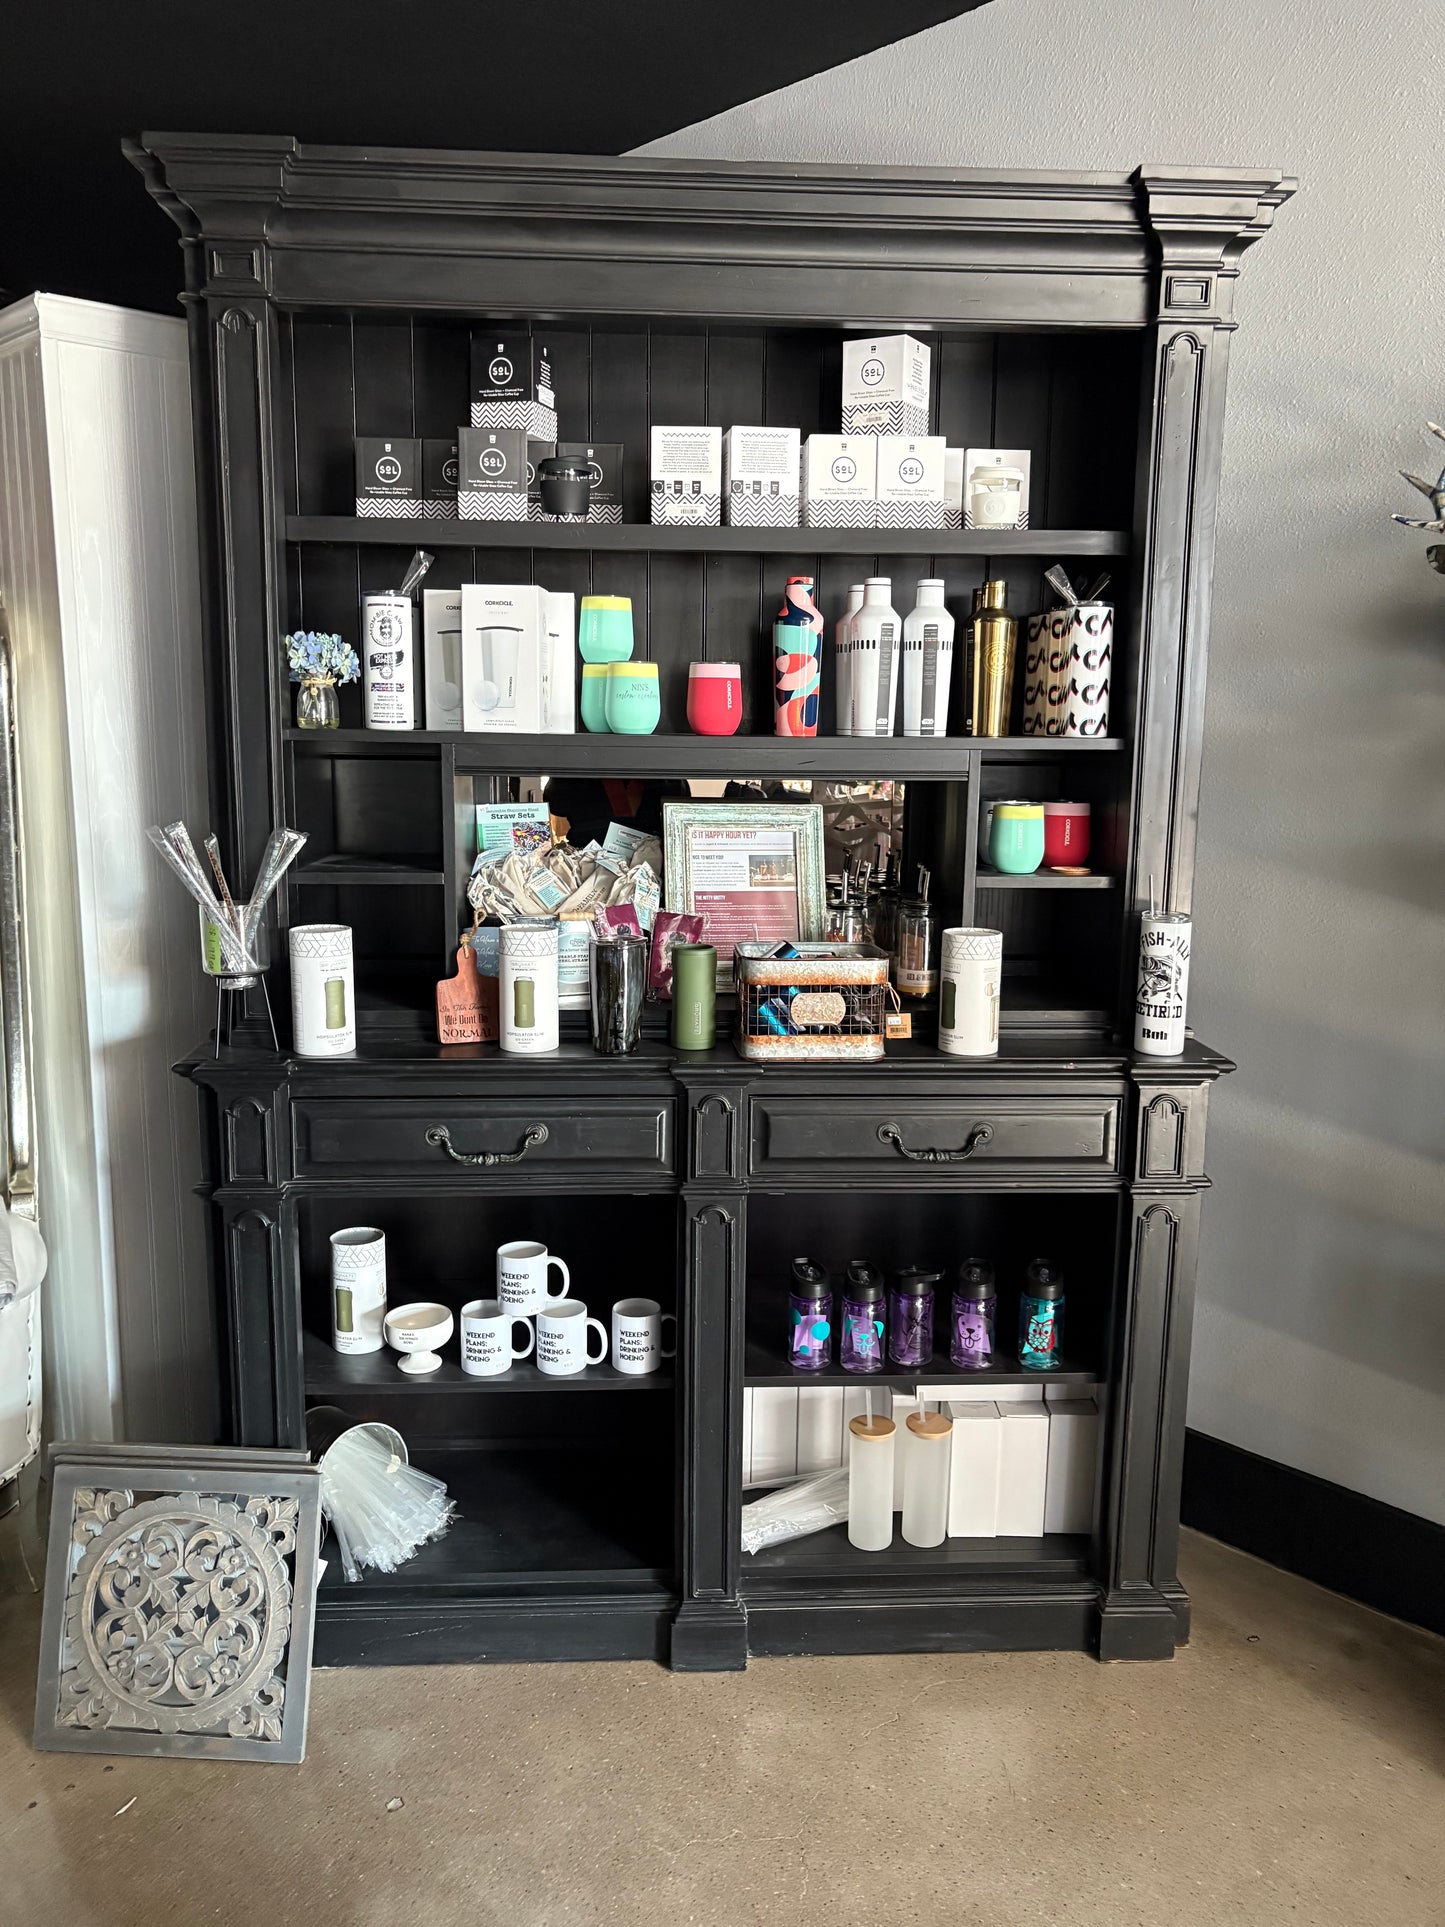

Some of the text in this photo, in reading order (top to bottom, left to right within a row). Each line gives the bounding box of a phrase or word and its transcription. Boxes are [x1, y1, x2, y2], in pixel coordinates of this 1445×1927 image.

[704, 831, 724, 839] HAPPY
[725, 831, 741, 839] HOUR
[742, 831, 757, 839] YET?
[444, 1015, 457, 1026] We
[442, 1028, 493, 1038] NORMAL
[500, 1272, 529, 1280] WEEKEND
[500, 1279, 522, 1288] PLANS:
[500, 1287, 530, 1296] DRINKING
[500, 1295, 525, 1304] HOEING
[465, 1331, 496, 1339] WEEKEND
[619, 1329, 650, 1338] WEEKEND
[465, 1338, 488, 1347] PLANS:
[619, 1337, 643, 1346] PLANS:
[465, 1346, 496, 1354] DRINKING
[619, 1346, 650, 1354] DRINKING
[466, 1354, 491, 1362] HOEING
[619, 1353, 645, 1361] HOEING
